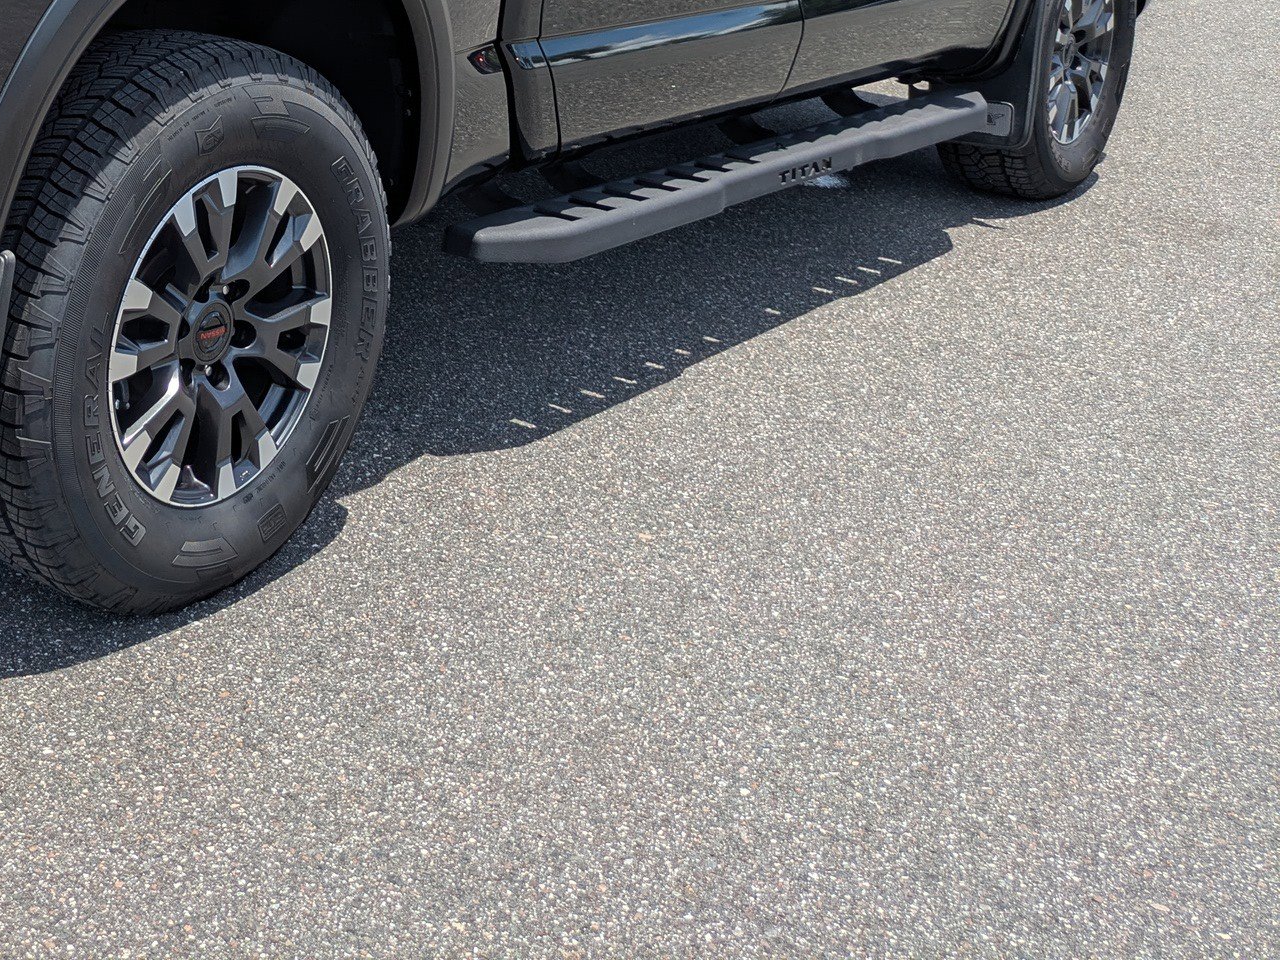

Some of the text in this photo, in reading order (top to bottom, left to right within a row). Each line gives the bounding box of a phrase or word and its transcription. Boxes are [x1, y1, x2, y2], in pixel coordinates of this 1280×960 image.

[779, 156, 832, 186] TITAN
[331, 155, 379, 362] GRABBER
[200, 325, 227, 340] NISSAN
[83, 312, 147, 547] GENERAL
